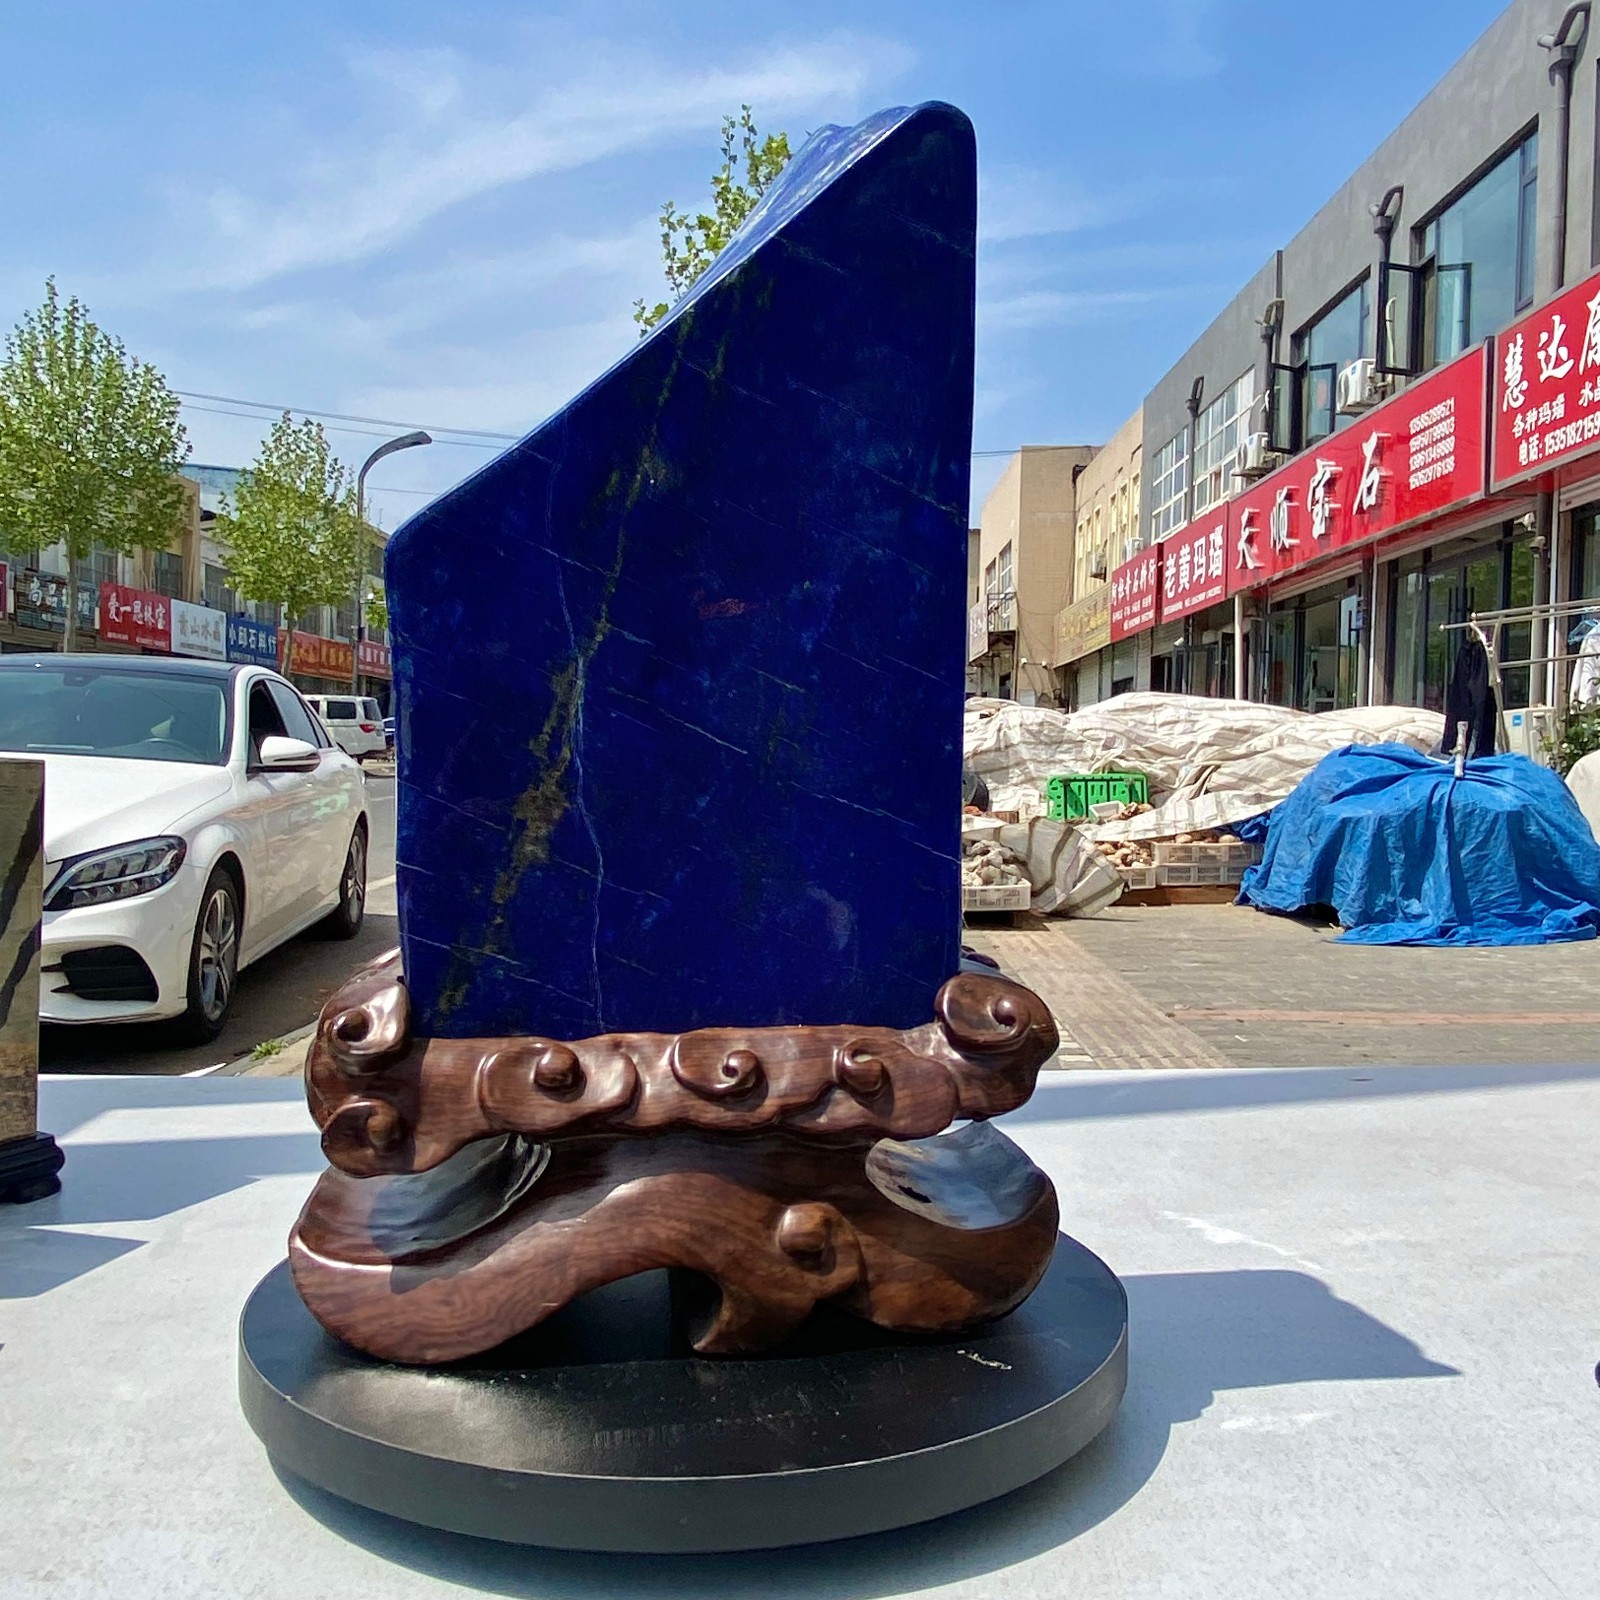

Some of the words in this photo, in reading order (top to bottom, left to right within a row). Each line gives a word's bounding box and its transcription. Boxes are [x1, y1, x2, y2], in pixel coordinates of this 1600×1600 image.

[1512, 392, 1565, 439] 各种玛瑙
[1164, 524, 1223, 599] 老黄玛瑙
